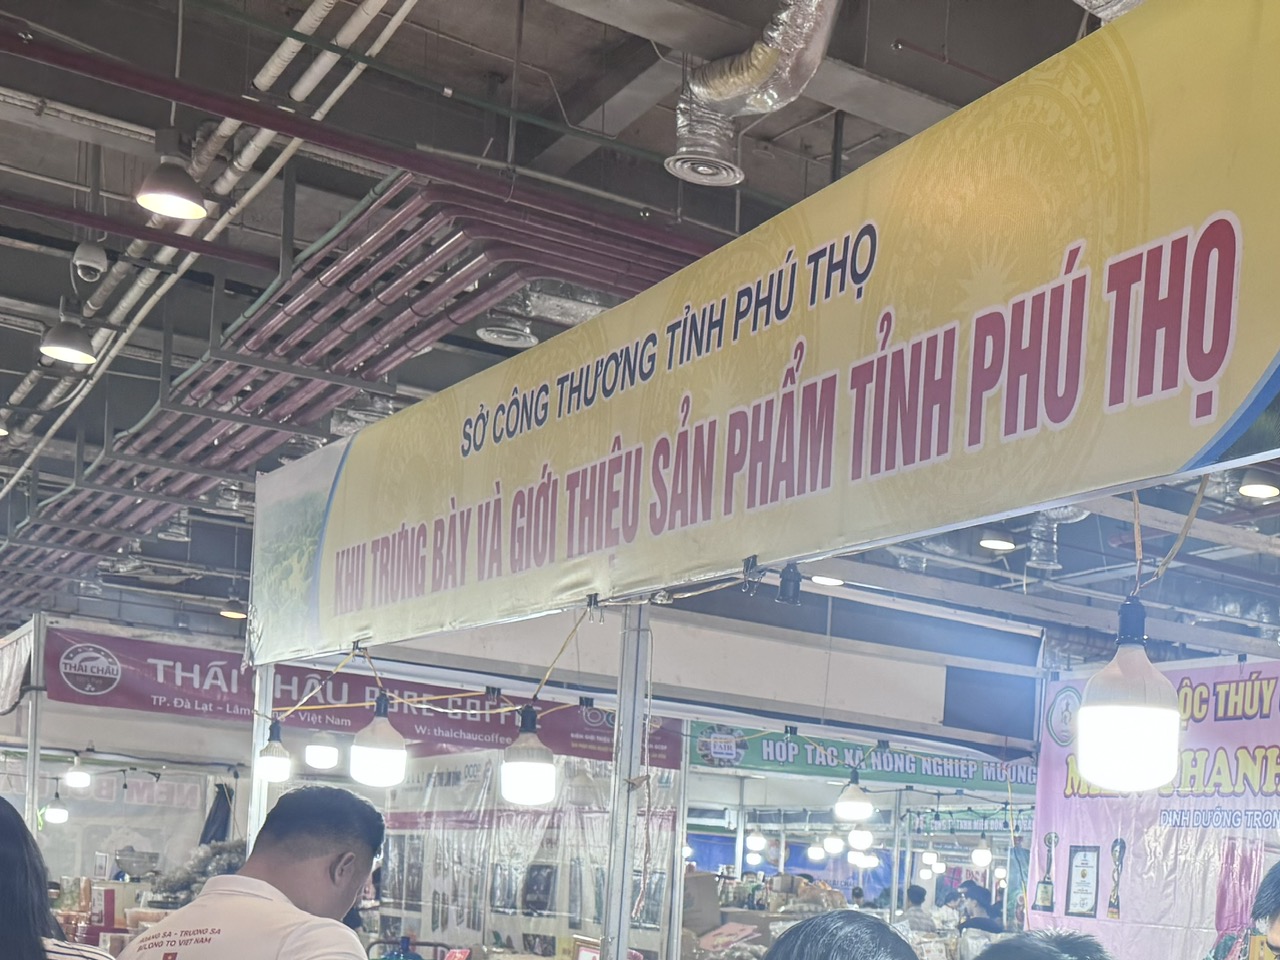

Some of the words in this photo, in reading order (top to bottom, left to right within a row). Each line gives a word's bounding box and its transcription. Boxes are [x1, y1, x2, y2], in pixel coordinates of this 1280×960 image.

[460, 411, 490, 460] SỞ
[491, 387, 552, 445] CÔNG
[555, 332, 659, 414] THƯƠNG
[665, 303, 727, 368] TỈNH
[732, 250, 798, 344] PHÚ
[806, 222, 878, 307] THỌ
[334, 543, 373, 618] KHU
[431, 497, 473, 594] BÀY
[475, 481, 504, 583] VÀ
[508, 464, 559, 569] GIỚI
[565, 433, 645, 570] THIỆU
[648, 394, 716, 536] SẢN
[724, 334, 838, 518] PHẨM
[849, 308, 958, 482] TỈNH
[967, 243, 1088, 450] PHÚ
[1105, 216, 1239, 420] THỌ
[62, 660, 88, 674] THÁI
[90, 664, 119, 677] CHÂU
[147, 658, 238, 694] THÁI
[251, 673, 349, 706] HÂU
[173, 697, 191, 710] Đà
[194, 701, 213, 713] Lạt
[1178, 676, 1210, 731] ỘC
[1213, 670, 1278, 721] THÚY
[298, 711, 323, 724] Việt
[325, 714, 351, 728] Nam
[762, 738, 799, 766] HỢP
[804, 742, 839, 767] TÁC
[871, 749, 916, 774] NÔNG
[921, 752, 978, 782] NGHIỆP
[1160, 808, 1191, 827] DINH
[1194, 805, 1242, 828] DƯỠNG
[165, 939, 177, 947] TO
[194, 936, 211, 945] NAM
[210, 927, 221, 936] SA
